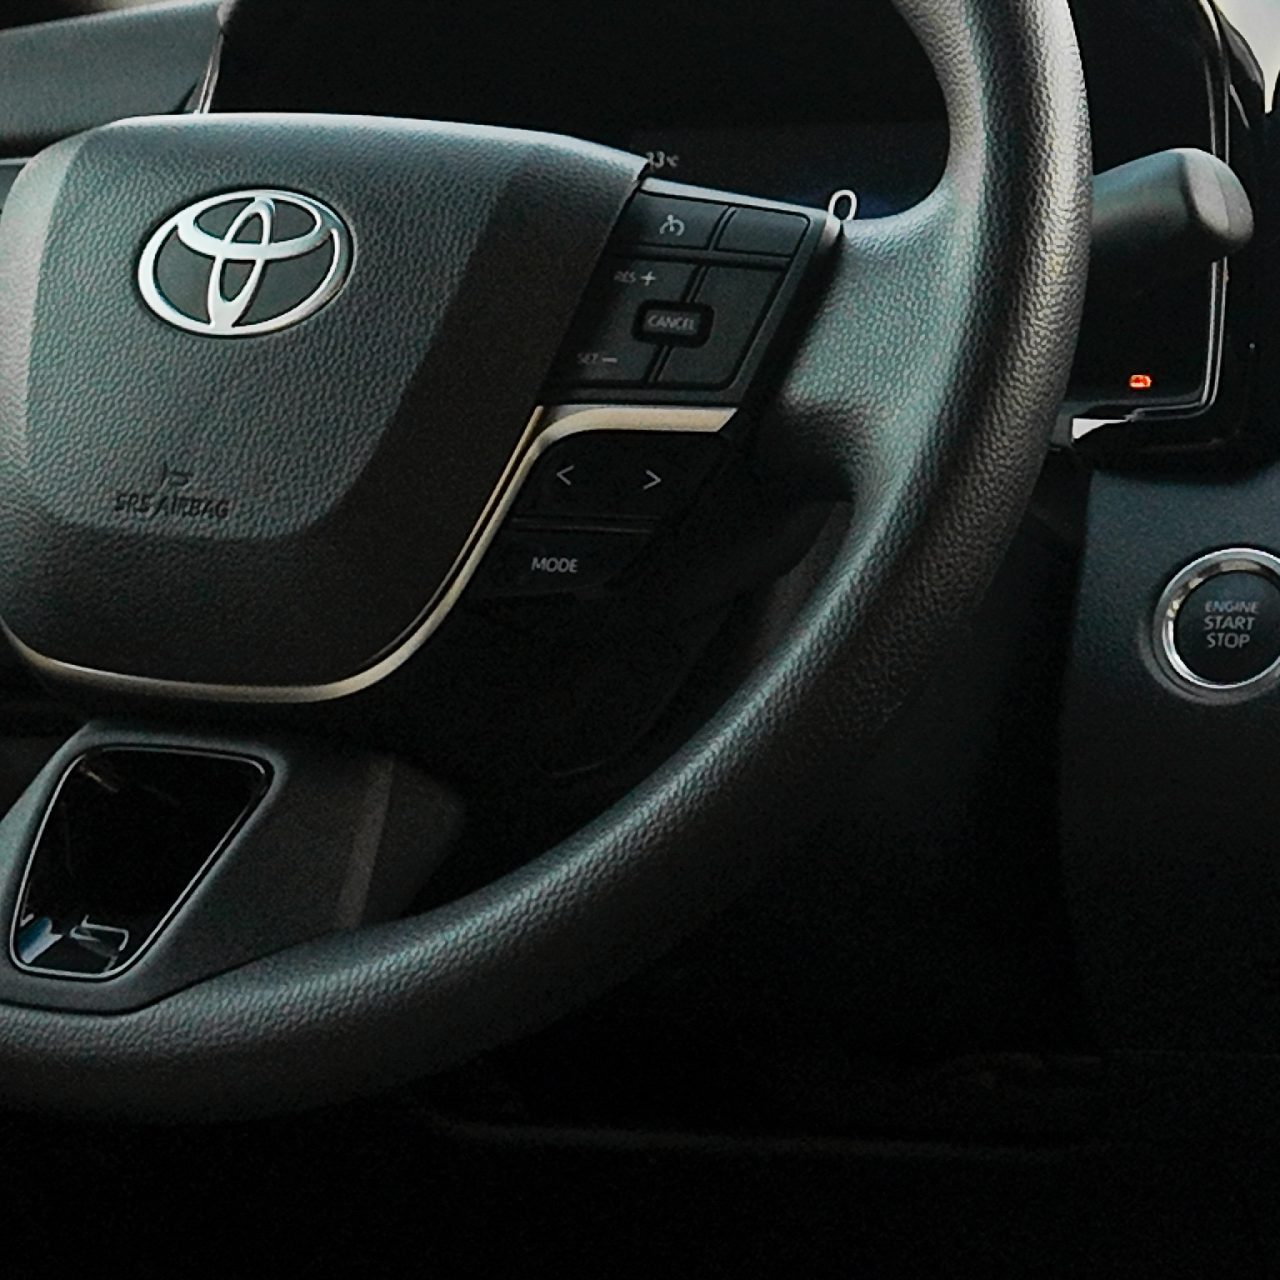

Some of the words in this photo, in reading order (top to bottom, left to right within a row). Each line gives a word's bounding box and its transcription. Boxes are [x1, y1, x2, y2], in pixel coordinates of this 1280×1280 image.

[647, 313, 695, 331] CANCEL
[113, 492, 154, 514] SRS
[150, 494, 231, 519] AIRBAG
[531, 556, 579, 573] MODE
[1204, 600, 1260, 615] ENGINE
[1203, 615, 1256, 631] START
[1206, 632, 1251, 649] STOP
